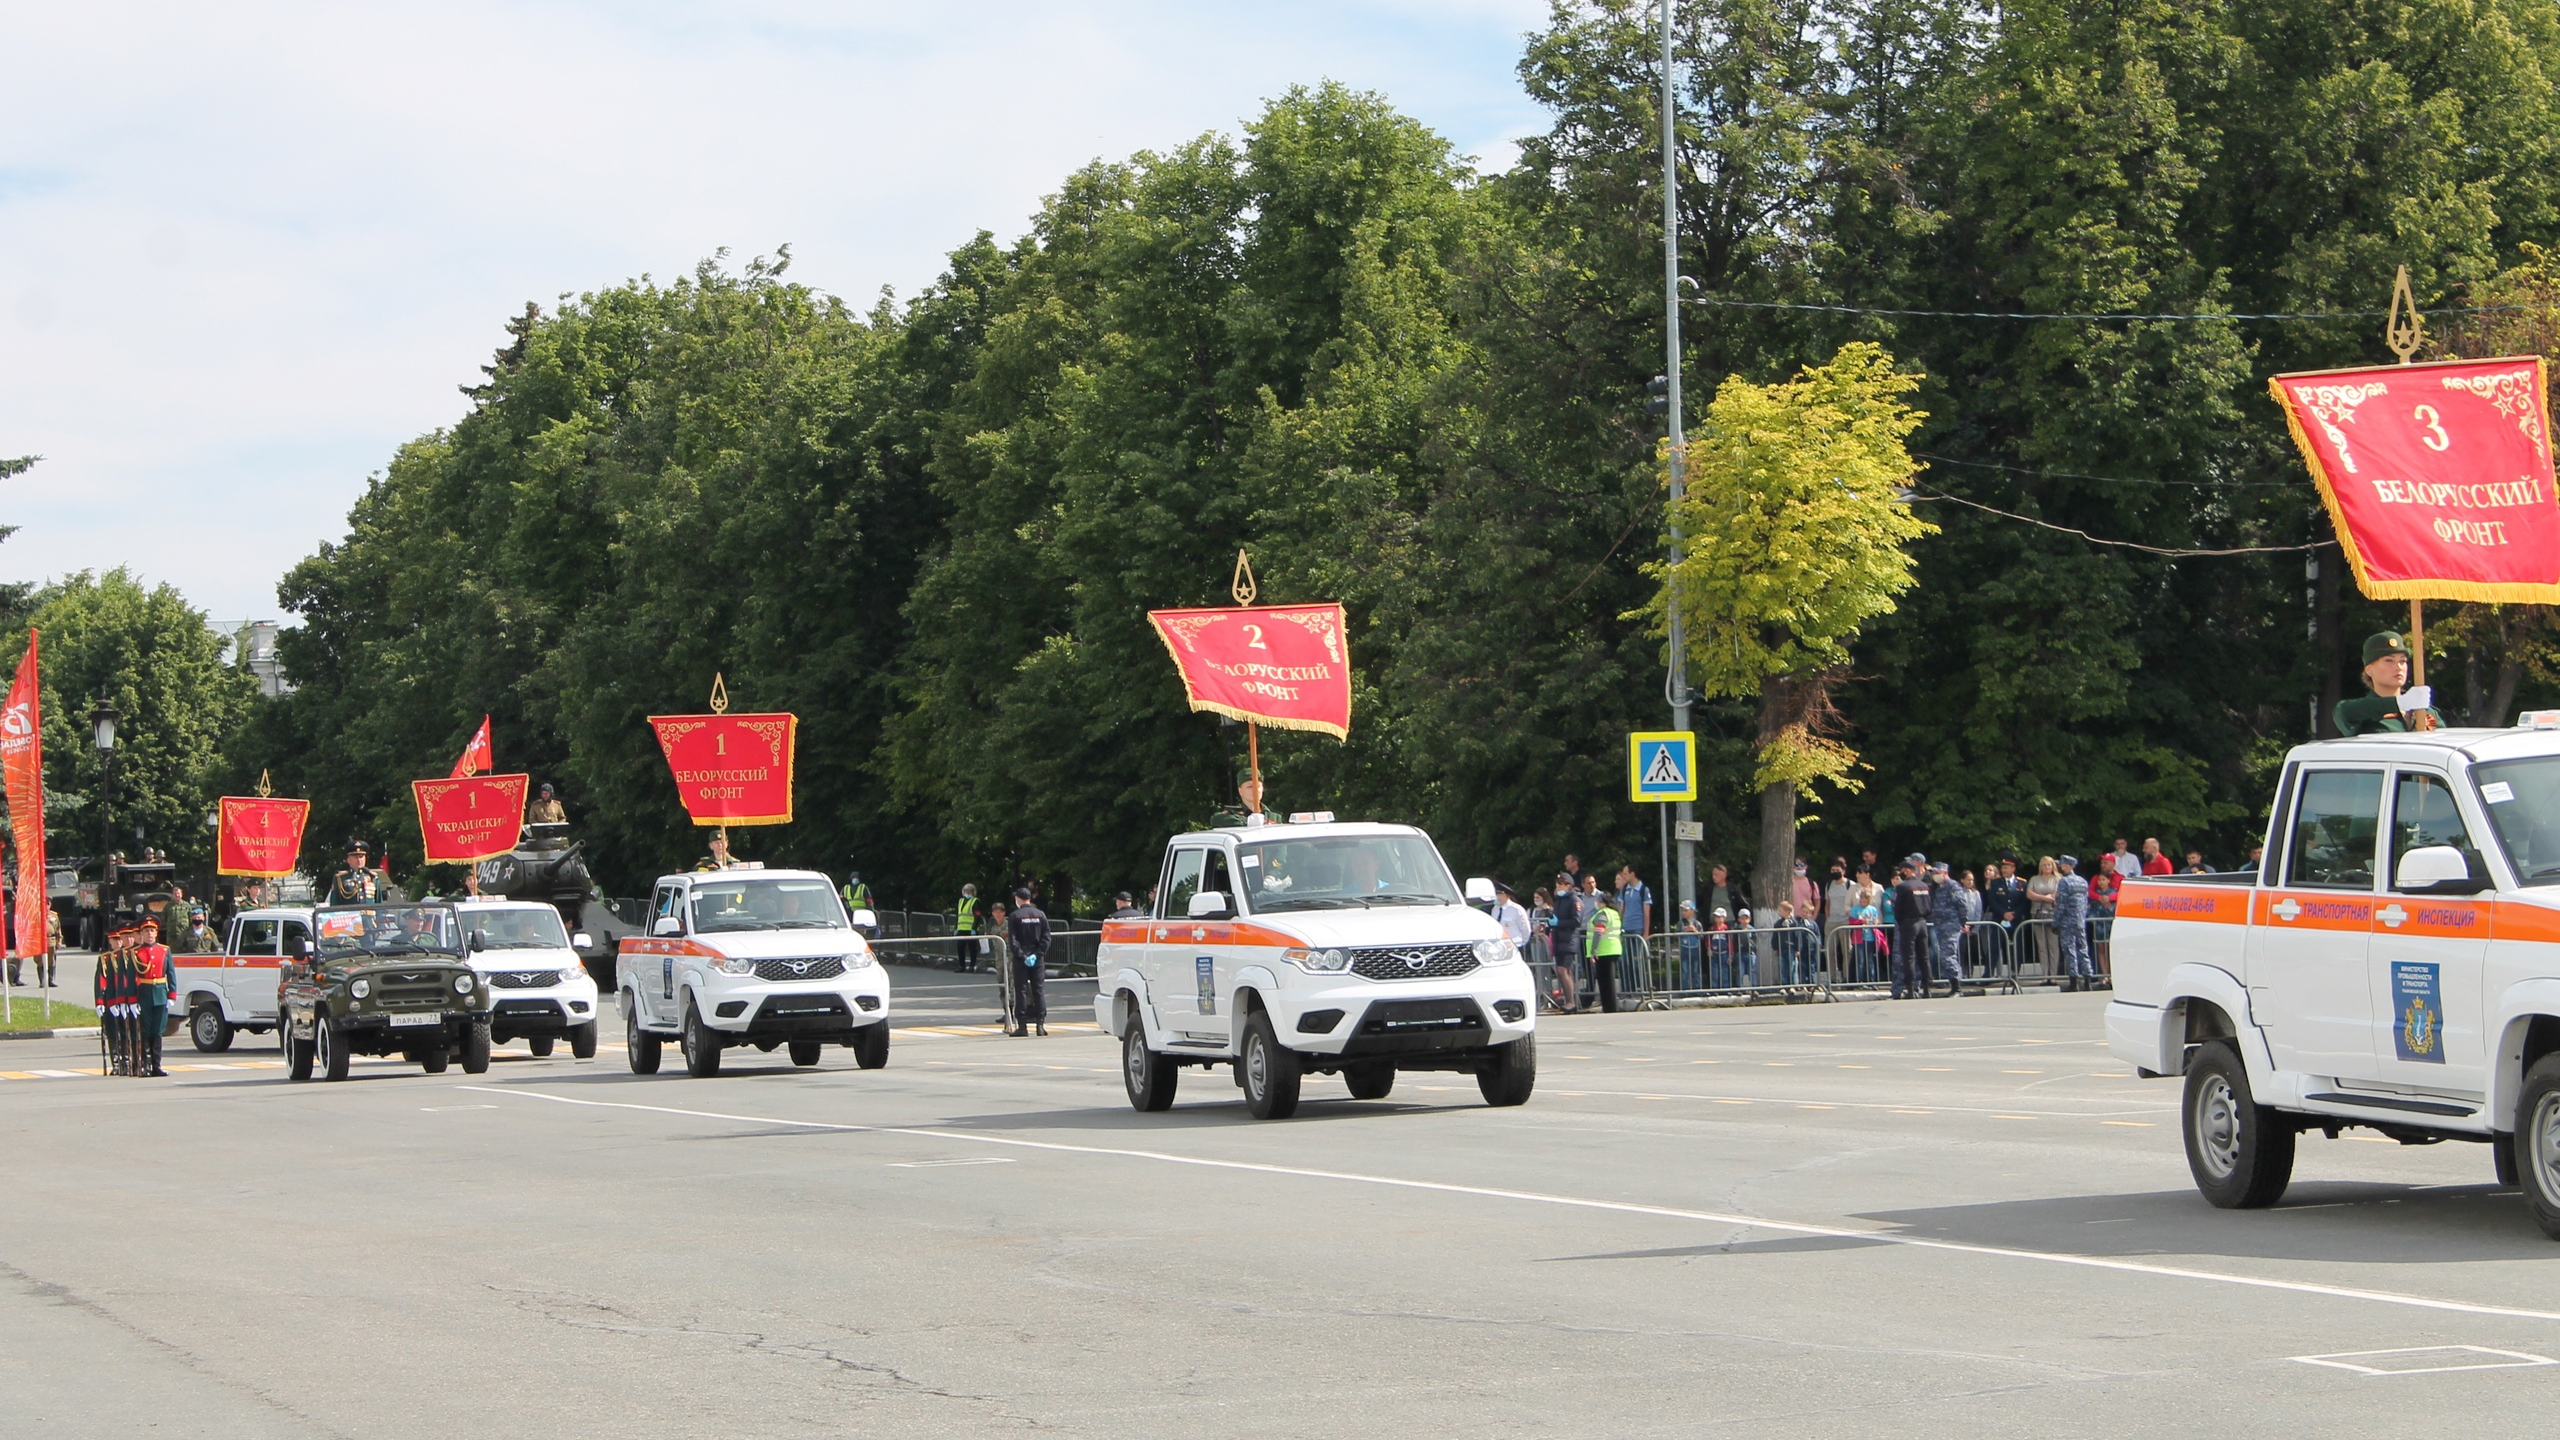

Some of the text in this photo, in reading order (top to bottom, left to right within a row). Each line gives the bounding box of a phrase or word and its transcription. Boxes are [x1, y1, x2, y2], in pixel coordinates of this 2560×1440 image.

[2413, 404, 2450, 452] 3
[2371, 474, 2545, 509] БЕЛОРУССКИЙ
[2433, 517, 2508, 546] ФРОНТ
[1242, 624, 1267, 650] 2
[716, 733, 727, 756] 1
[675, 766, 768, 783] БЕЛОРУССКИЙ
[468, 791, 477, 810] 1
[699, 786, 745, 800] ФРОНТ
[260, 811, 270, 828] 4
[233, 836, 290, 847] УКРАИНСКИЙ
[457, 831, 492, 845] ФРОНТ
[248, 849, 276, 860] ФРОНТ
[2303, 903, 2476, 929] ТРАНСПОРТНАЯ ИНСПЕКЦИЯ
[396, 1017, 423, 1025] ПАРАД
